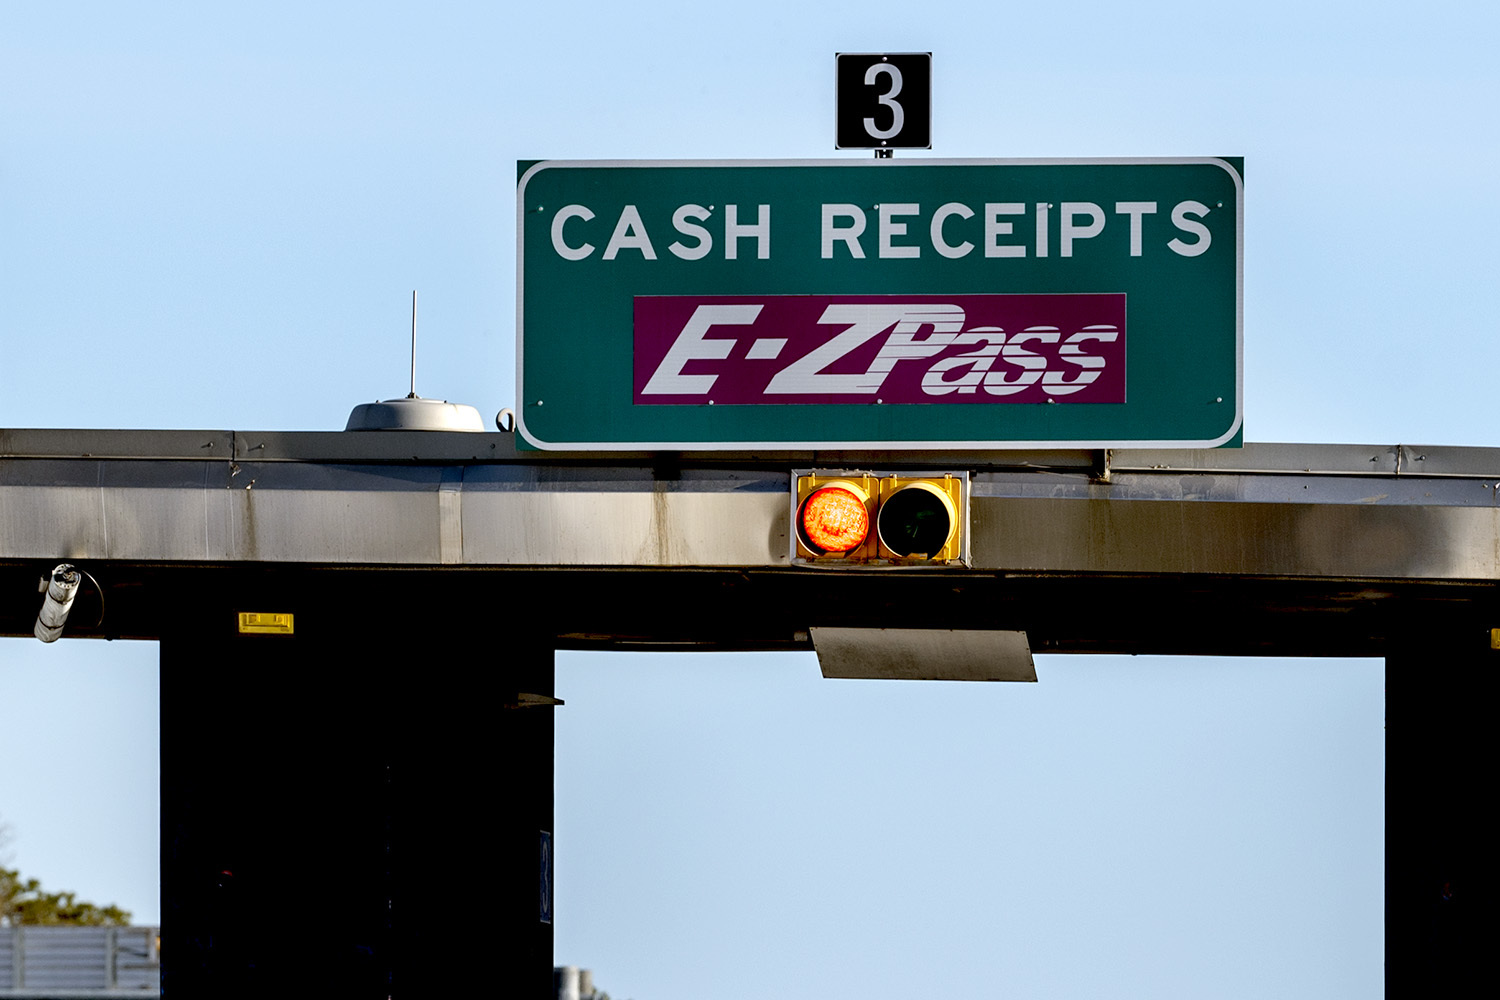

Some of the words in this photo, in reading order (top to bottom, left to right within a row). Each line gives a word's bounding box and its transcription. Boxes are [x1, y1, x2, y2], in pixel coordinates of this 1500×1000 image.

[863, 63, 905, 140] 3
[550, 204, 771, 261] CASH
[820, 201, 1213, 260] RECEIPTS
[640, 303, 1120, 396] E-ZPass
